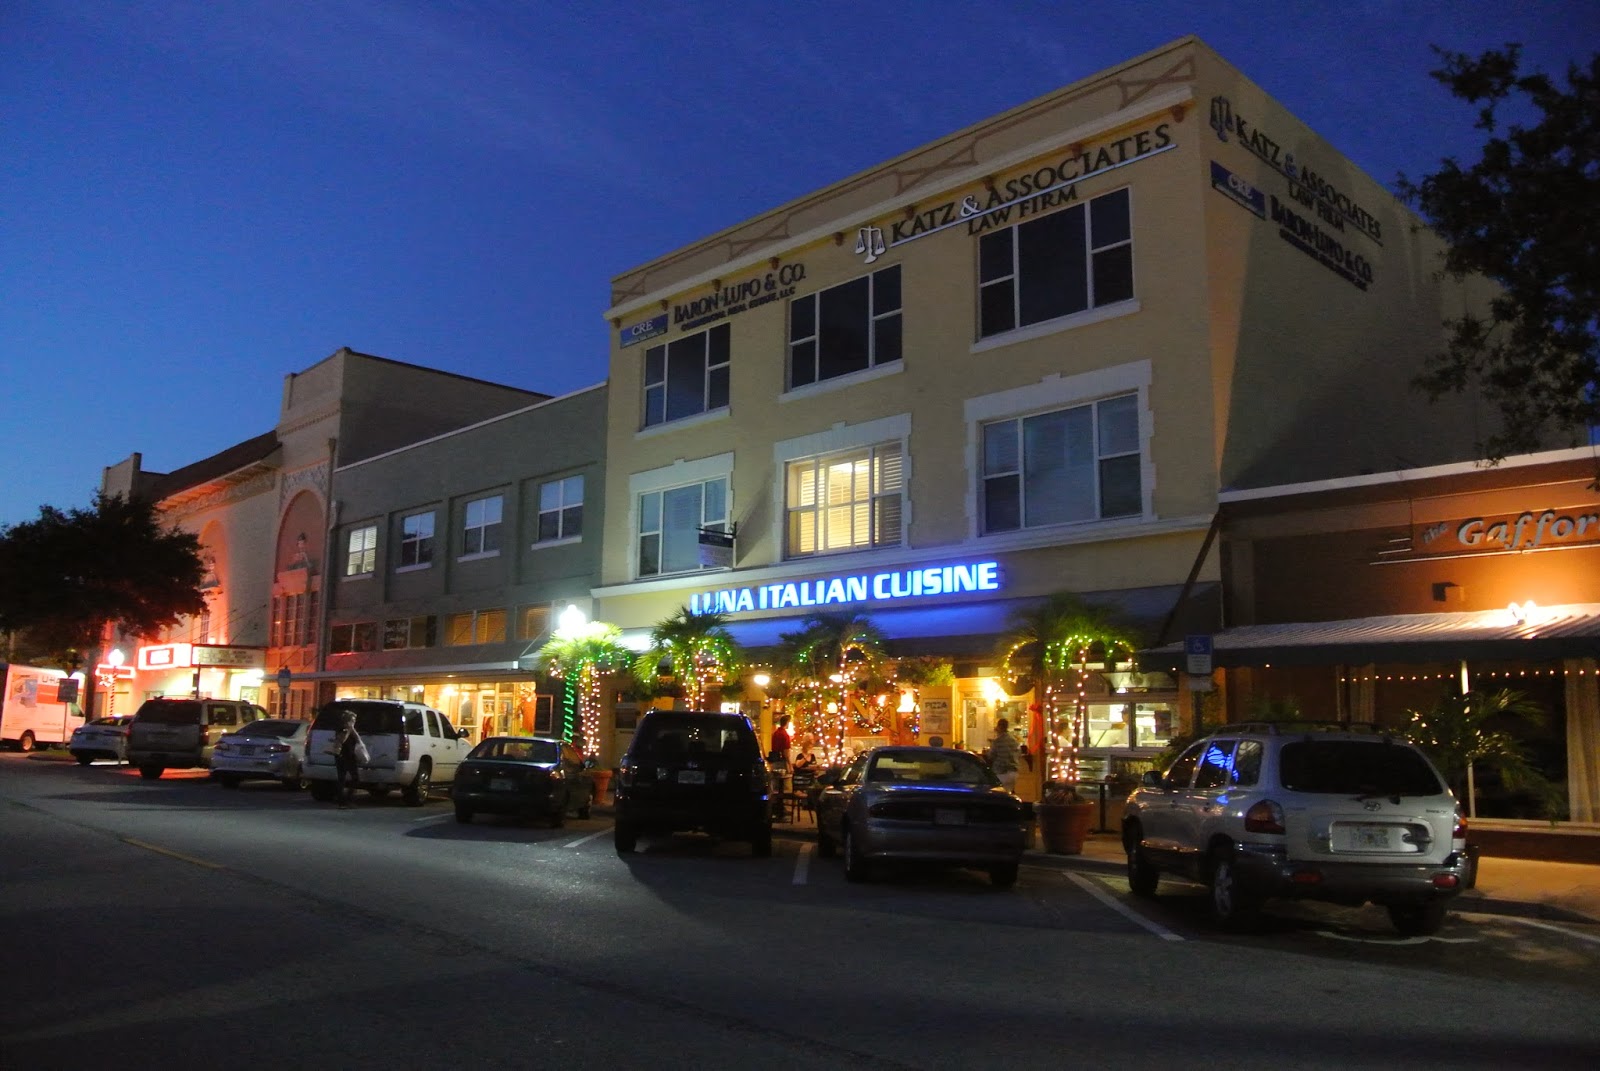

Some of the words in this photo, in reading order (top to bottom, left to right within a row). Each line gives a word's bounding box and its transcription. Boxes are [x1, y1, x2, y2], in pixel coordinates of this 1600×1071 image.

[890, 201, 957, 244] KATZ
[959, 195, 982, 218] &
[986, 123, 1172, 207] ASSOCIATES
[1235, 113, 1282, 168] KATZ
[1301, 165, 1382, 240] ASSOCIATES
[967, 206, 1013, 236] LAW
[1018, 185, 1079, 218] FIRM
[764, 273, 776, 292] &
[779, 263, 807, 286] CO.
[631, 320, 655, 337] CRE
[1457, 508, 1600, 551] Gaffor
[690, 588, 755, 617] LUNA
[758, 575, 868, 610] ITALIAN
[872, 561, 999, 600] CUISINE
[924, 700, 948, 710] PIZZA
